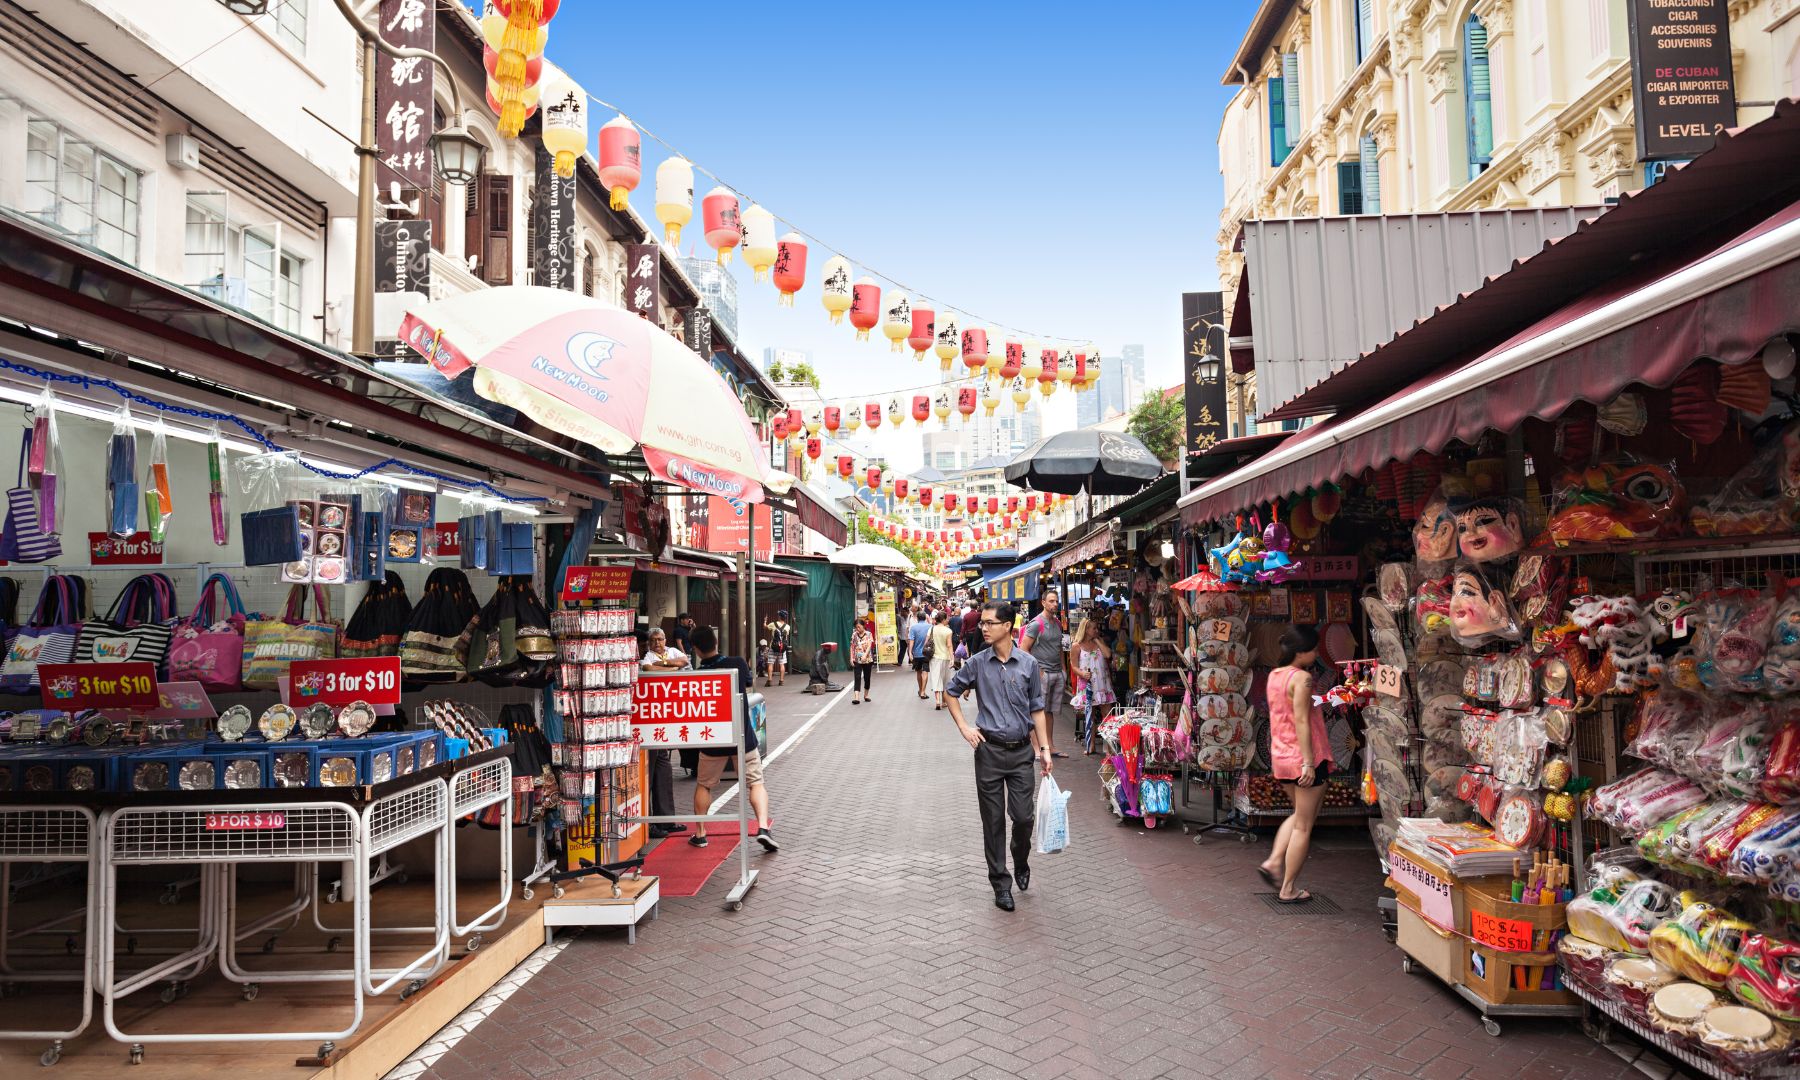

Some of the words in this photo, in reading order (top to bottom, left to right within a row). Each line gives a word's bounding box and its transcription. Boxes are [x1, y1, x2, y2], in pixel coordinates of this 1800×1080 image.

[1668, 11, 1698, 21] CIGAR
[1651, 24, 1717, 35] ACCESSORIES
[1657, 38, 1712, 48] SOUVENIRS
[1656, 68, 1672, 78] DE
[1676, 67, 1719, 77] CUBAN
[1647, 82, 1677, 92] CIGAR
[1680, 80, 1729, 91] IMPORTER
[1659, 96, 1666, 105] &
[1669, 95, 1719, 105] EXPORTER
[1660, 124, 1710, 138] LEVEL
[548, 209, 560, 256] Heritage
[396, 228, 410, 293] Chinato
[444, 532, 452, 546] 3
[114, 542, 121, 555] 3
[123, 541, 139, 555] for
[141, 540, 162, 555] $10
[1213, 621, 1227, 634] $2
[254, 643, 322, 657] SINGAPORE
[79, 677, 90, 695] 3
[93, 677, 116, 694] for
[120, 675, 150, 695] $10
[325, 673, 336, 692] 3
[339, 672, 362, 691] for
[365, 670, 395, 692] $10
[1381, 669, 1396, 687] $3
[636, 680, 722, 699] UTY-FREE
[209, 816, 217, 827] 3
[220, 815, 250, 827] FOR
